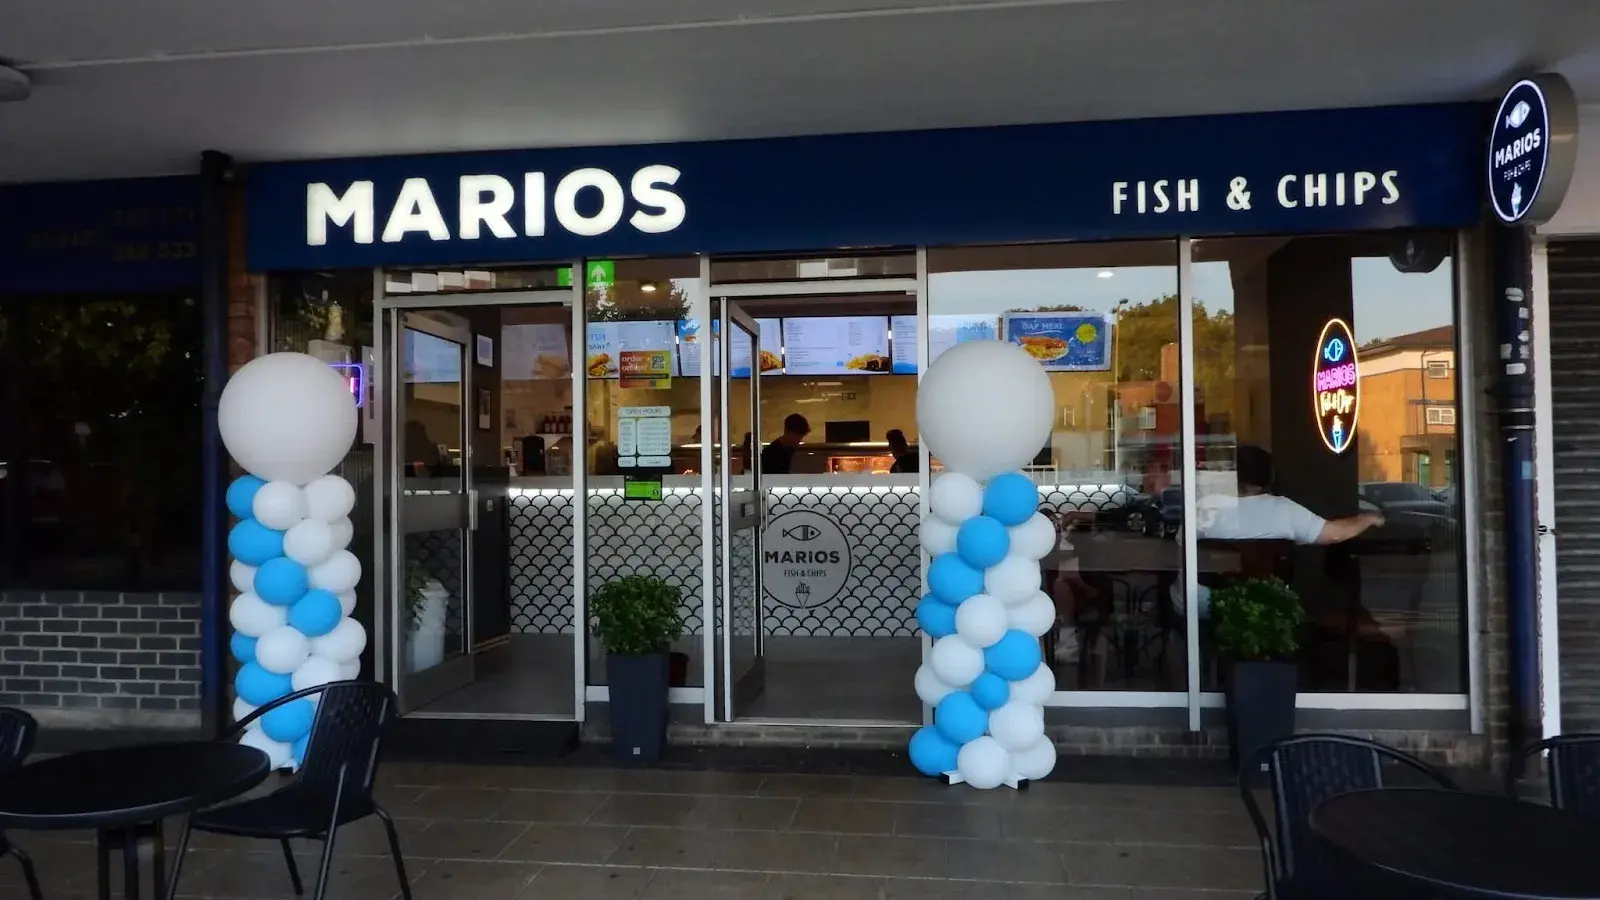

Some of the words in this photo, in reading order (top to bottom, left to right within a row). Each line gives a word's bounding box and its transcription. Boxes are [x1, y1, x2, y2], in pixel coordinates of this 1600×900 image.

[1495, 128, 1541, 168] MARIOS
[306, 164, 687, 246] MARIOS
[1112, 178, 1199, 214] FISH
[1226, 176, 1252, 211] &
[1276, 170, 1400, 208] CHIPS
[1317, 363, 1356, 391] MARIOS
[764, 550, 840, 564] MARIOS
[784, 569, 799, 577] FISH
[800, 569, 806, 577] &
[807, 569, 827, 577] CHIPS
